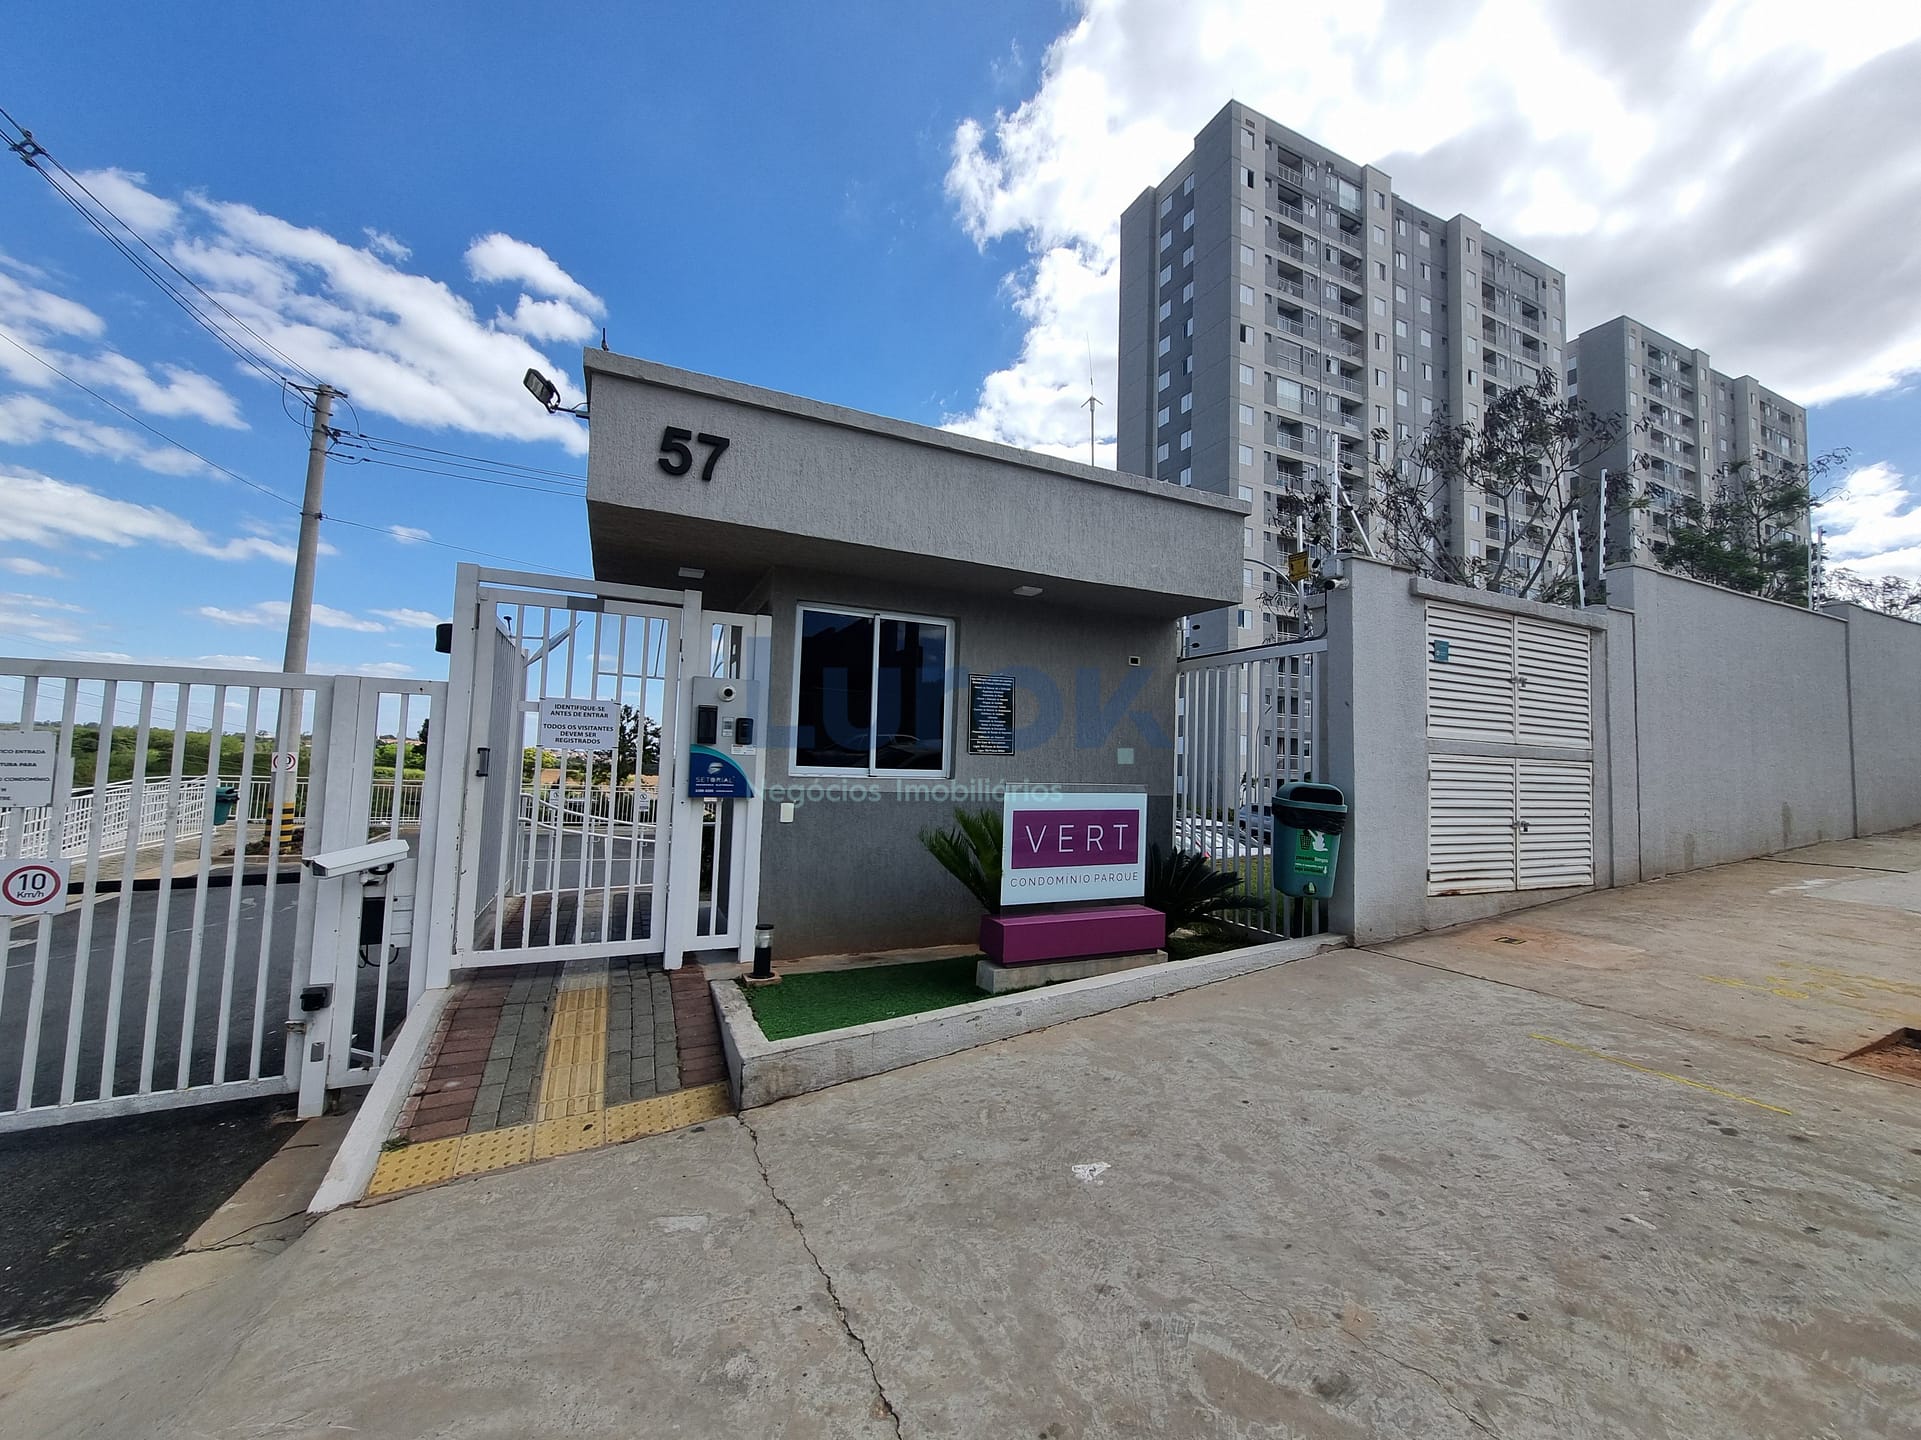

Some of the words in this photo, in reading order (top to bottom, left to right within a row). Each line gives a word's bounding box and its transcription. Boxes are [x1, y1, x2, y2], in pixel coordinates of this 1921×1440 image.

[658, 426, 730, 481] 57
[554, 703, 606, 712] IDENTIFIQUE-SE
[577, 724, 614, 732] VISITANTES
[555, 737, 601, 745] REGISTRADOS
[1025, 824, 1129, 853] VERT
[19, 873, 47, 891] 10
[1010, 872, 1091, 888] CONDOMÍNIO
[1093, 871, 1139, 883] PARQUE
[17, 890, 45, 898] Km/h
